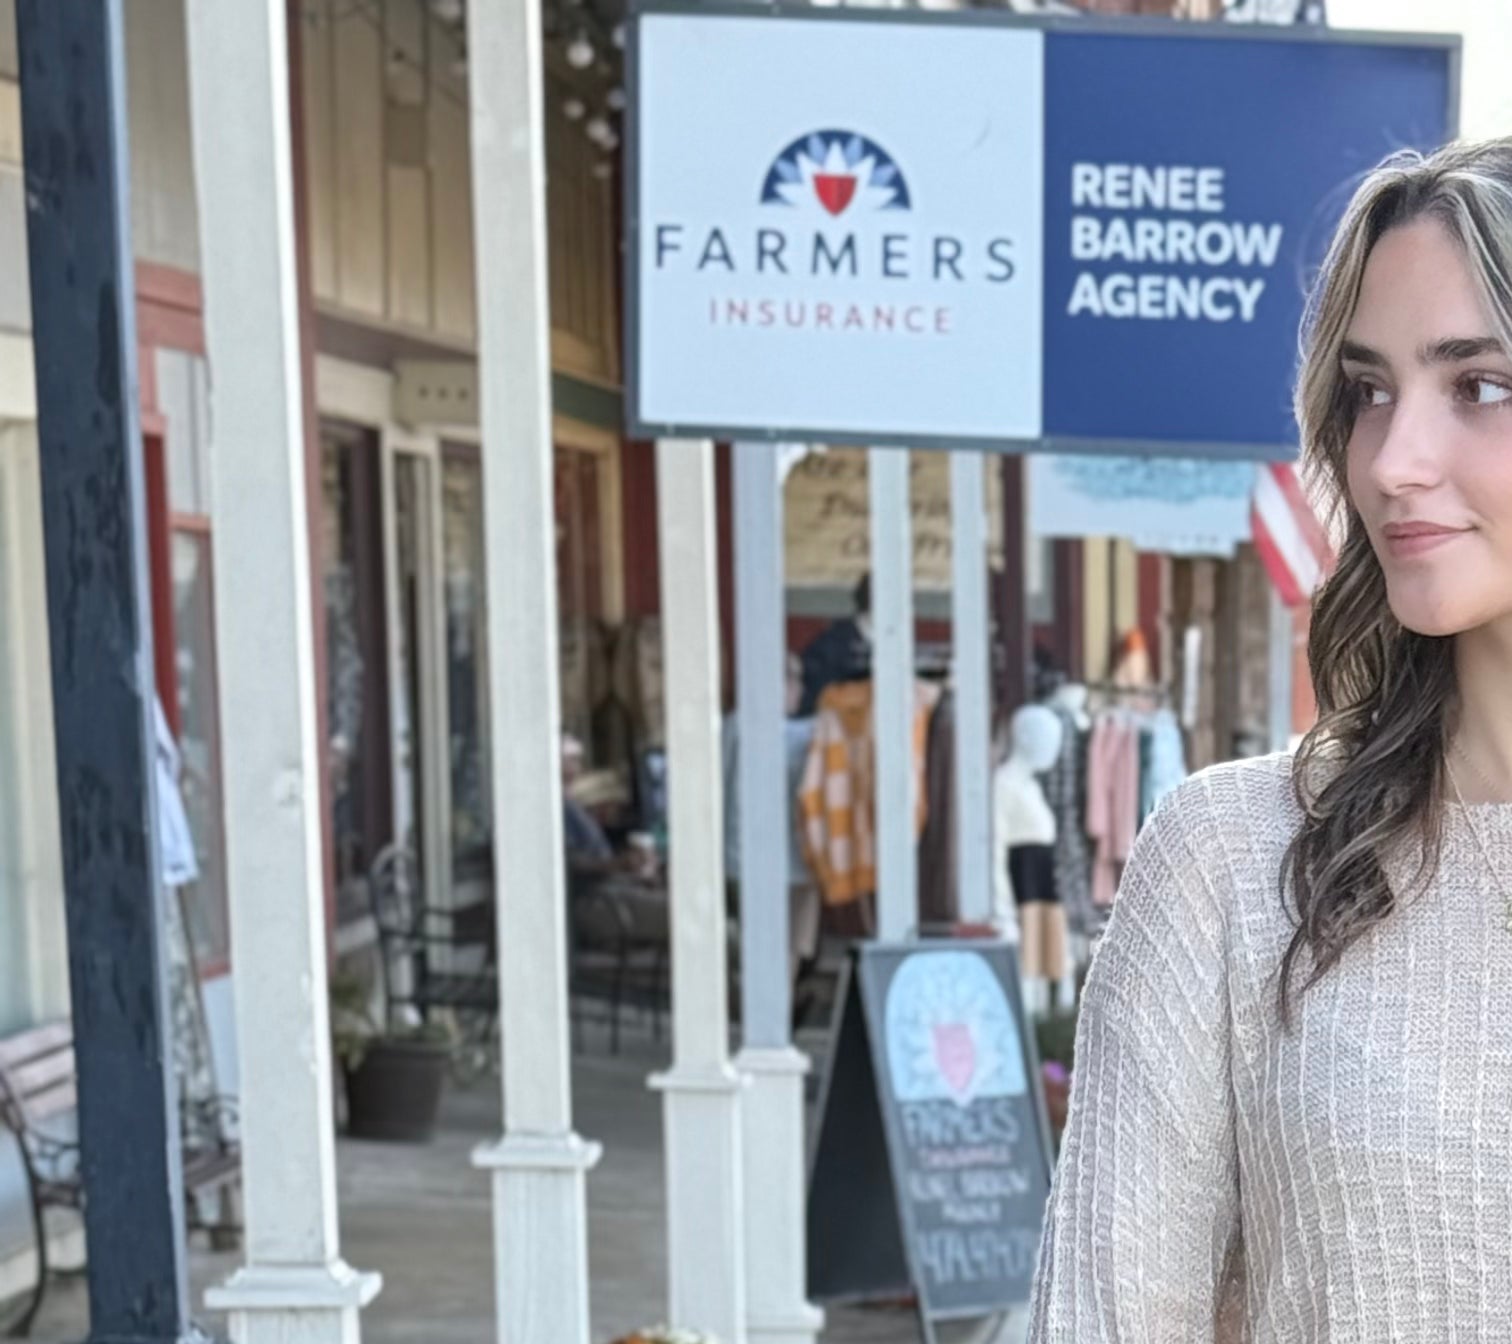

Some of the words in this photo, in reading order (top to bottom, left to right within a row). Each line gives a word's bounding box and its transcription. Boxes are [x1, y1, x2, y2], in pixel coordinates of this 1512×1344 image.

[1072, 163, 1224, 212] RENEE
[654, 224, 1017, 283] FARMERS
[1071, 216, 1282, 266] BARROW
[708, 297, 953, 334] INSURANCE
[1067, 272, 1265, 322] AGENCY
